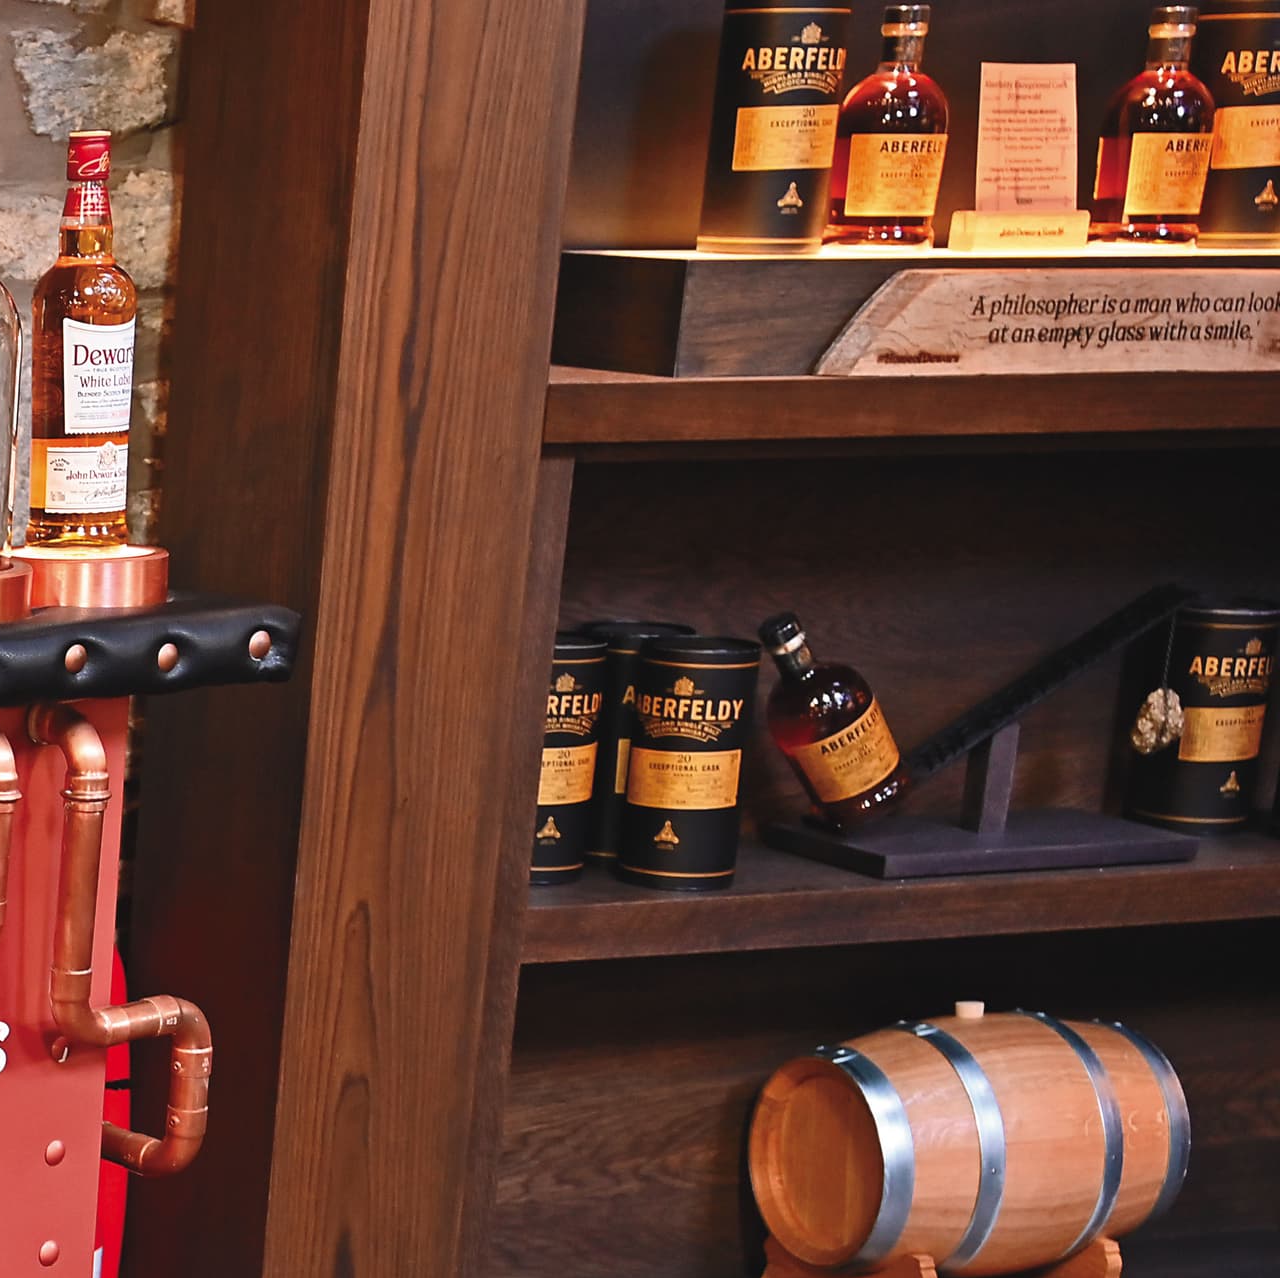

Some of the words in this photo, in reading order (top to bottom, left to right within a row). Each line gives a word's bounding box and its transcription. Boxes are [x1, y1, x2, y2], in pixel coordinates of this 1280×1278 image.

[988, 292, 1099, 322] philosopher
[1102, 294, 1116, 314] is
[1120, 298, 1131, 313] a
[1134, 297, 1171, 313] man
[1176, 292, 1210, 313] who
[1214, 297, 1246, 313] can
[988, 324, 1009, 344] at
[1011, 327, 1036, 343] an
[1038, 325, 1094, 350] empty
[1097, 320, 1146, 349] glass
[1150, 320, 1187, 341] with
[1190, 324, 1202, 340] a
[638, 693, 744, 721] BERFELDY
[557, 750, 571, 760] 20
[677, 754, 692, 763] 20
[649, 762, 698, 772] EXCEPTIONAL
